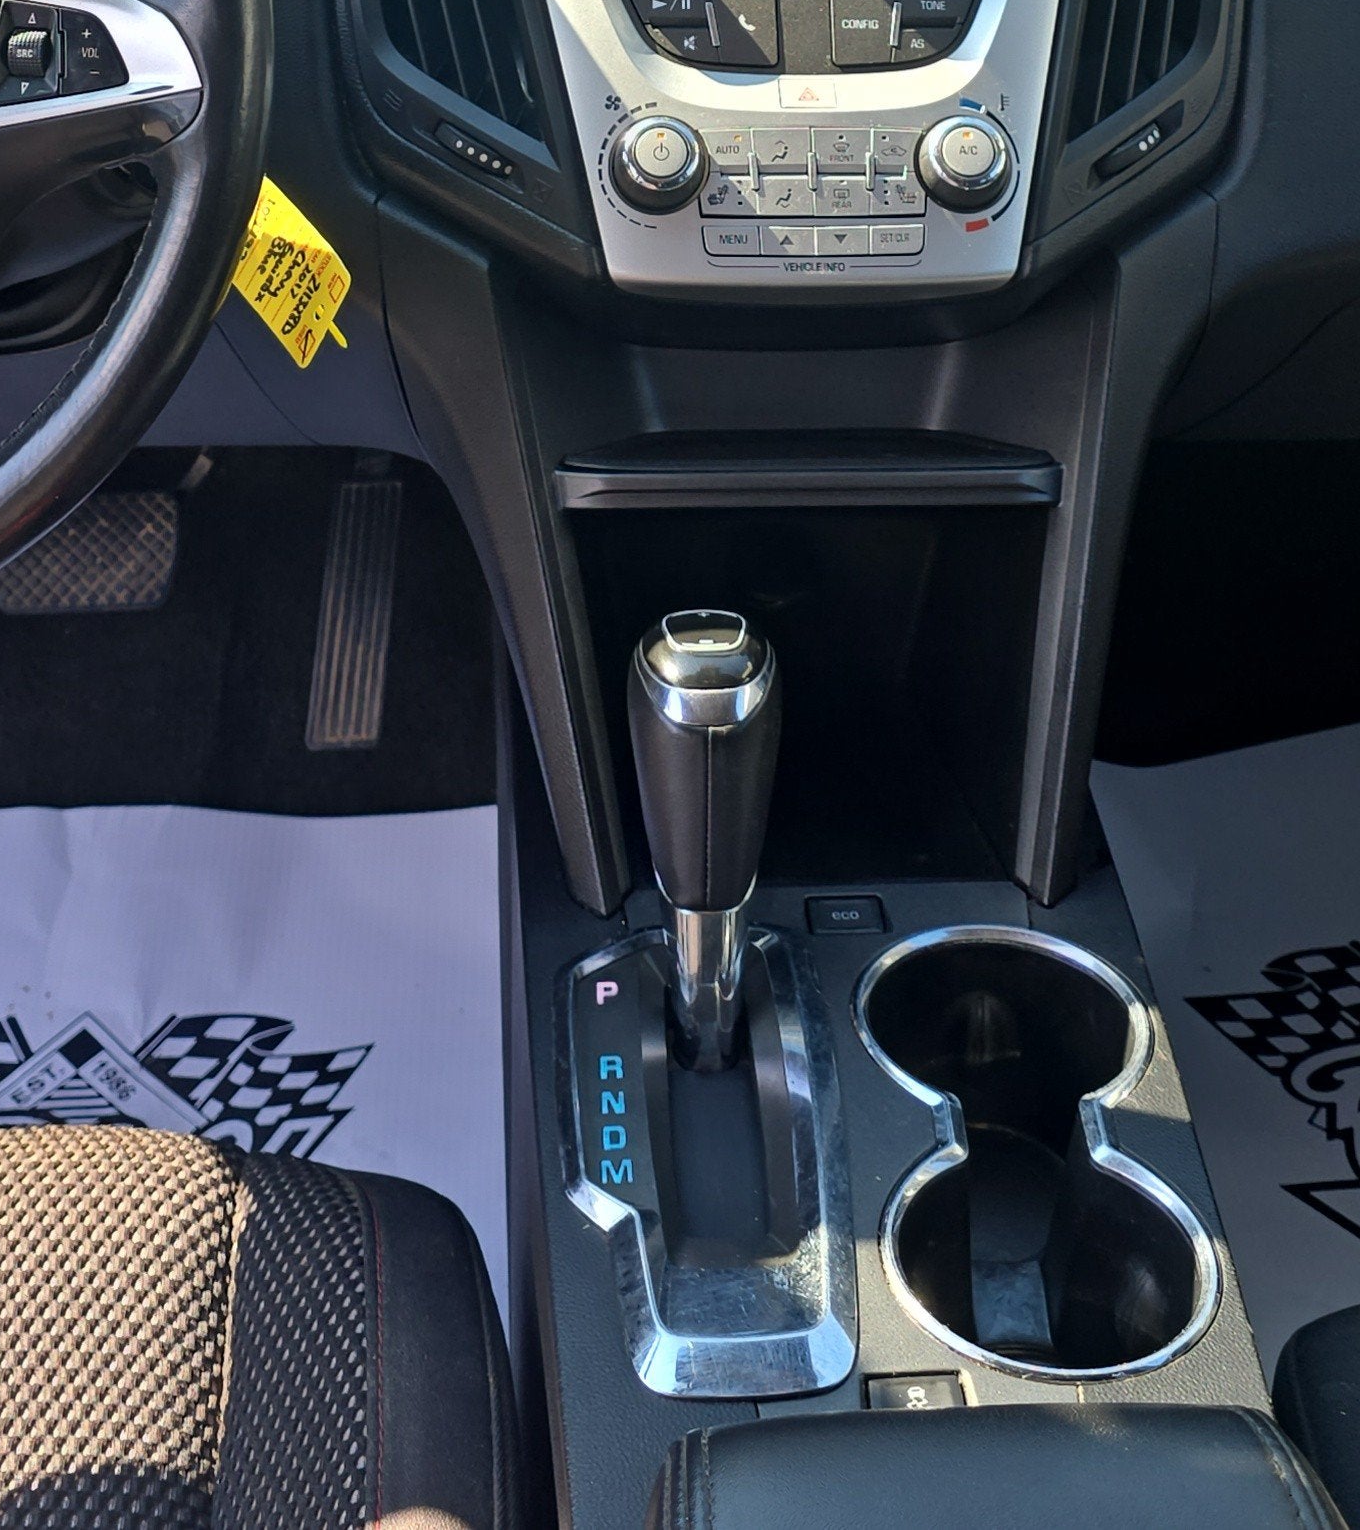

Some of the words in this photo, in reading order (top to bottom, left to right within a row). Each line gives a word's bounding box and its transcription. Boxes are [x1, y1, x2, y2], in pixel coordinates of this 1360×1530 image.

[920, 0, 946, 11] TONE
[841, 19, 880, 30] CONFIG
[910, 38, 925, 49] AS
[16, 48, 34, 59] SRC
[81, 47, 100, 59] VOL
[715, 144, 740, 155] AUTO
[959, 145, 979, 157] A/C
[829, 154, 854, 162] FRONT
[719, 234, 748, 245] MENU
[880, 233, 894, 243] SET
[783, 261, 822, 272] VEHICLE
[823, 261, 846, 272] INFO
[831, 909, 859, 921] eco
[596, 981, 619, 1006] P
[599, 1055, 623, 1080] R
[93, 1060, 137, 1102] 1986
[601, 1091, 626, 1115] N
[602, 1125, 627, 1151] D
[601, 1159, 633, 1185] M
